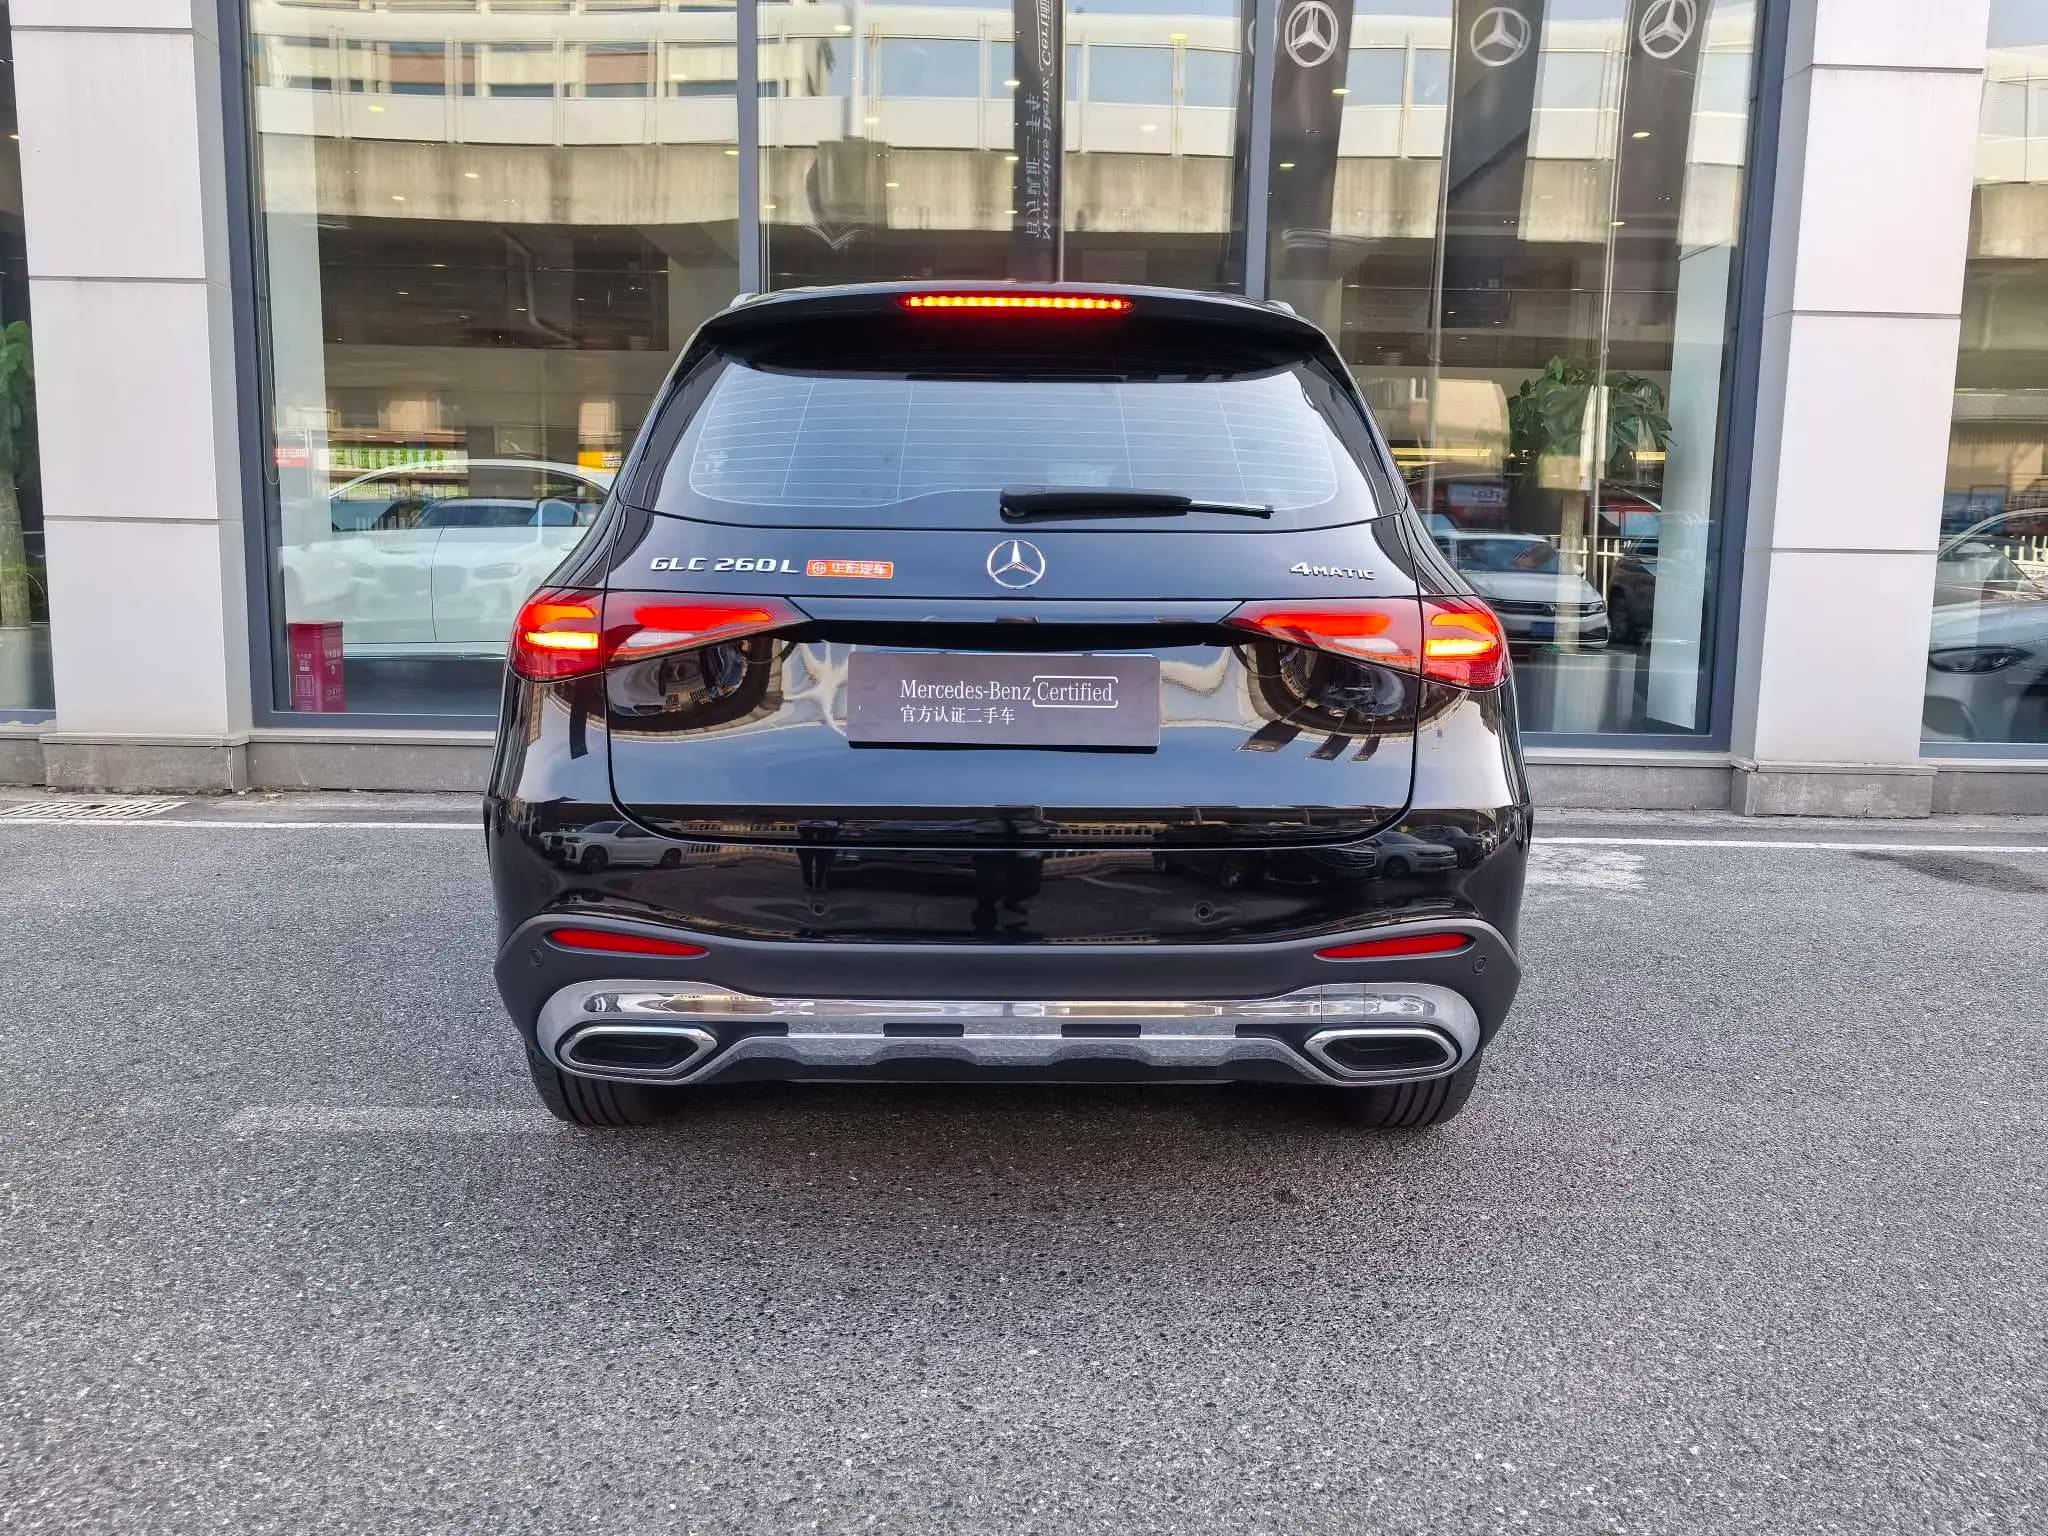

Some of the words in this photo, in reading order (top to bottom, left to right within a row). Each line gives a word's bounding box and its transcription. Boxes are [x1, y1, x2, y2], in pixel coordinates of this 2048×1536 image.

[650, 557, 709, 572] GLC
[1290, 561, 1377, 581] 4MATIC
[900, 679, 1032, 701] Mercedes-Benz
[1037, 681, 1112, 702] Certified
[900, 704, 1015, 725] 官方认证二手车
